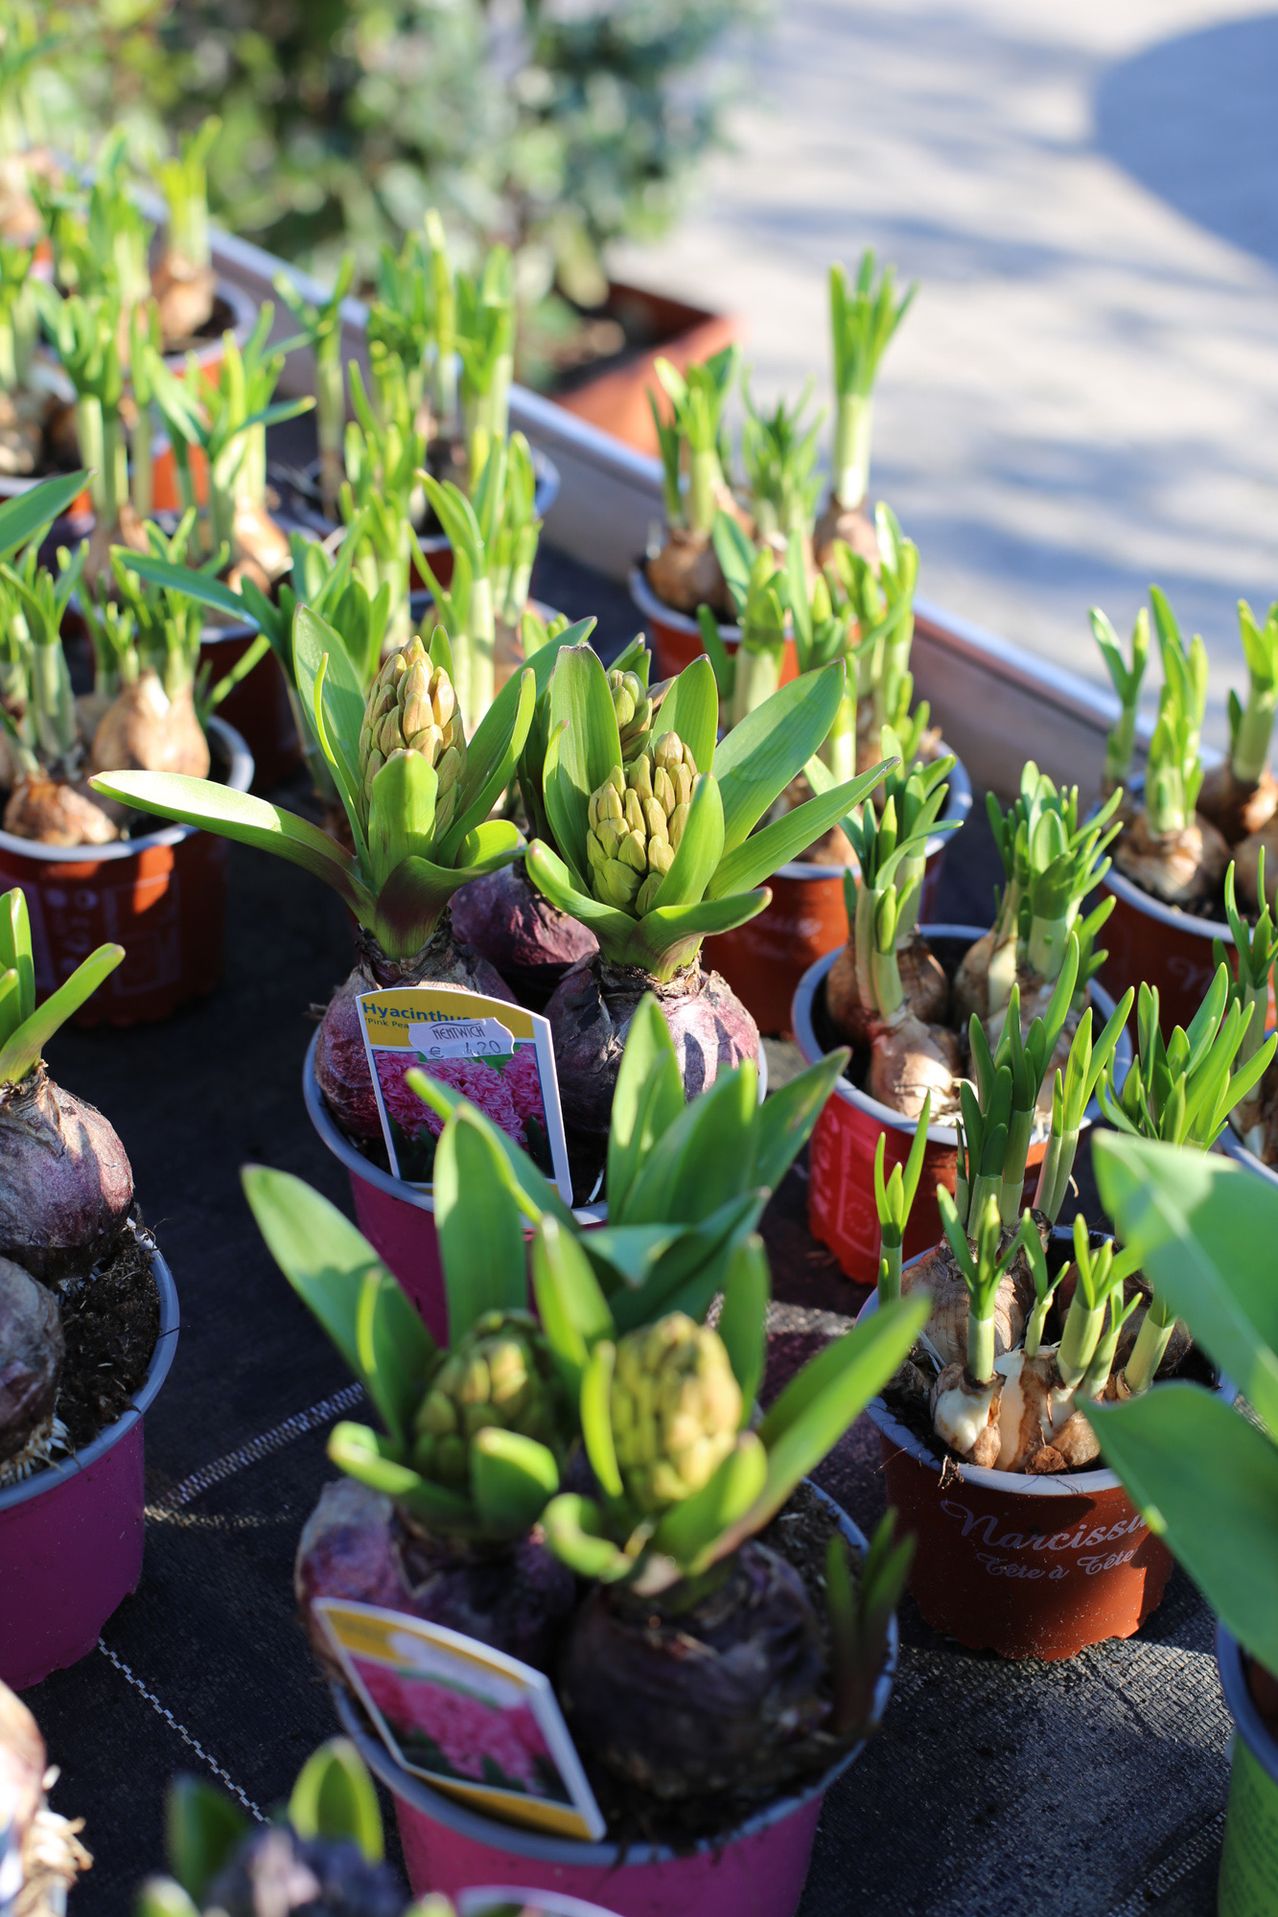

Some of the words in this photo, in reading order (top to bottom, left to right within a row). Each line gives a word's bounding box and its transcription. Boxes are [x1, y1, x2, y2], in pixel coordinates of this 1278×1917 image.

[362, 1002, 471, 1021] Hyacinthu
[430, 1047, 444, 1058] €
[940, 1499, 1149, 1550] Narcissu
